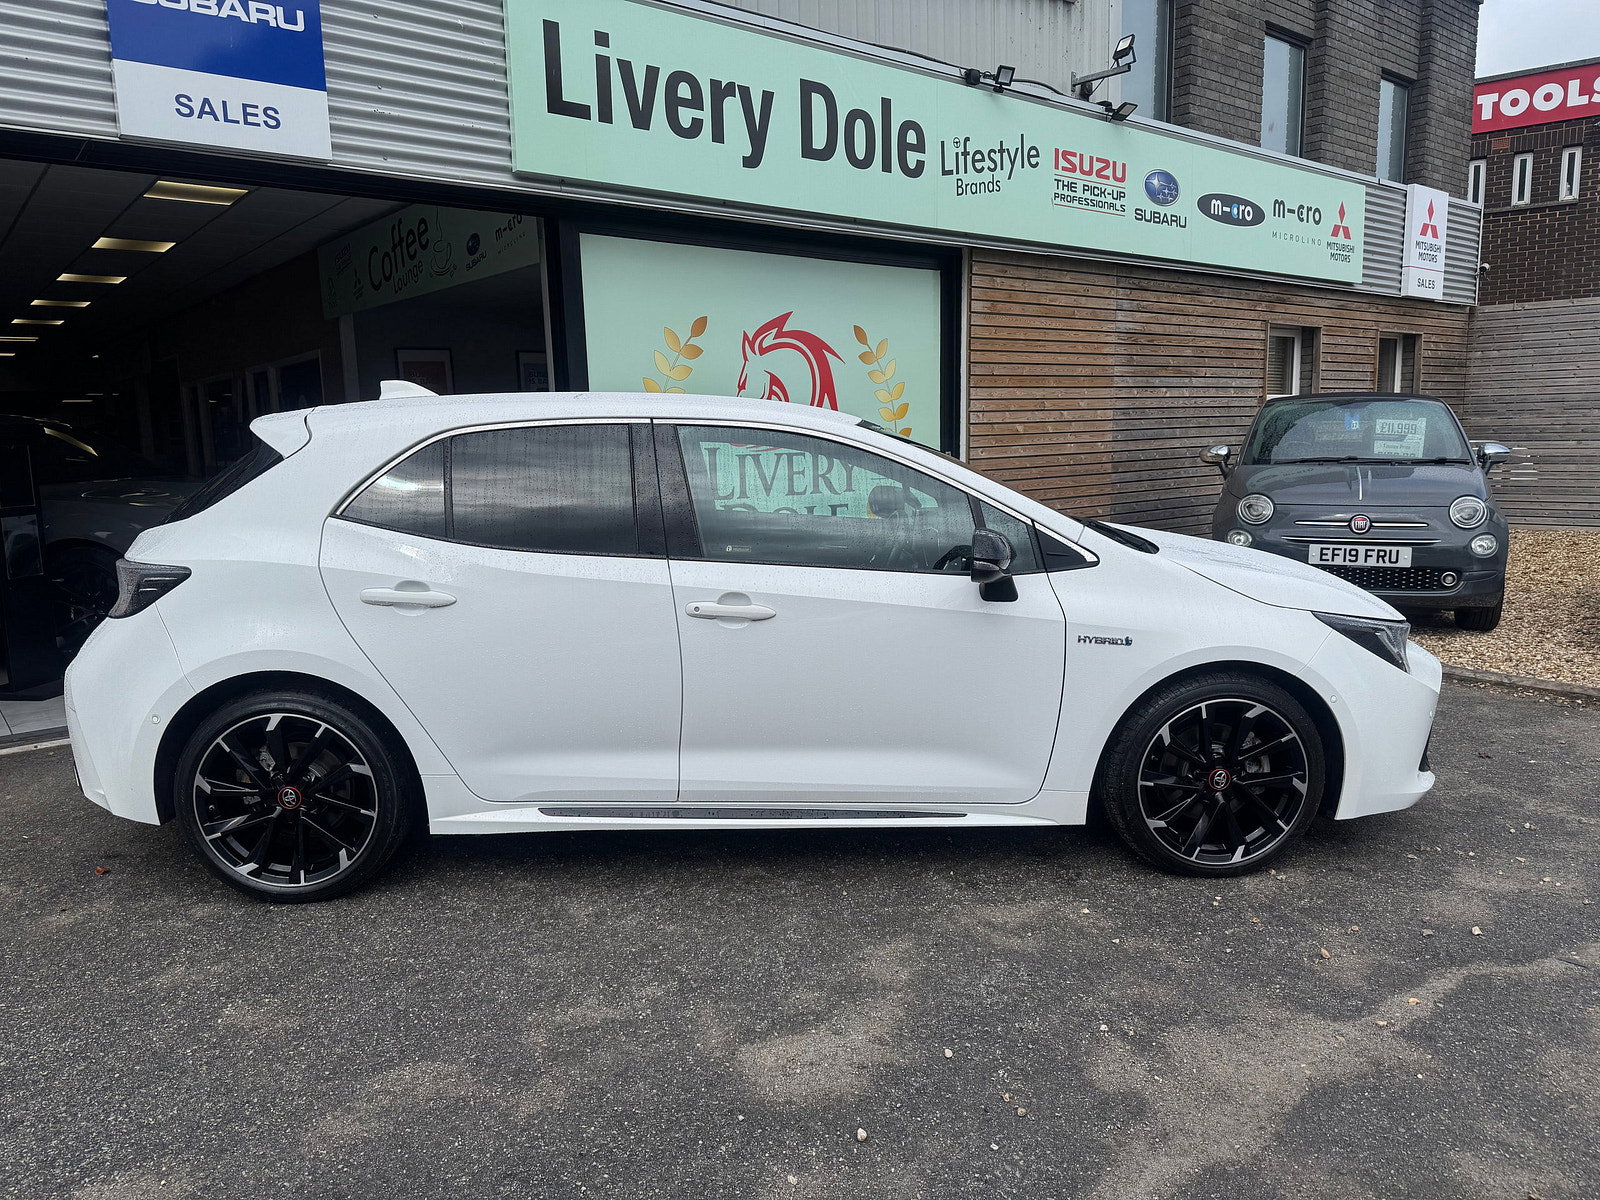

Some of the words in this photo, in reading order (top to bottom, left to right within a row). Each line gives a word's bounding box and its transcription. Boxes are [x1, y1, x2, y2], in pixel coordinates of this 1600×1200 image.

[131, 0, 305, 32] BARU
[542, 18, 775, 169] Livery
[800, 78, 926, 179] Dole
[174, 93, 281, 130] SALES
[940, 133, 1040, 181] Lifestyle
[1054, 147, 1126, 183] ISUZU
[956, 174, 1001, 197] Brands
[1054, 178, 1077, 193] THE
[1082, 183, 1126, 201] PICK-UP
[1053, 192, 1126, 213] PROFESSIONALS
[1134, 207, 1187, 229] SUBARU
[1271, 230, 1322, 247] MICROLINO
[1326, 241, 1355, 254] MITSUBISHI
[1415, 240, 1442, 254] MITSUBISHI
[368, 217, 430, 291] Coffee
[1329, 252, 1351, 263] MOTORS
[1418, 251, 1438, 263] MOTORS
[393, 260, 424, 294] Lounge
[1417, 277, 1436, 290] SALES
[704, 447, 855, 501] LIVERY
[1319, 547, 1359, 563] EF19
[1364, 548, 1400, 565] FRU
[1077, 635, 1124, 646] HYBRID
